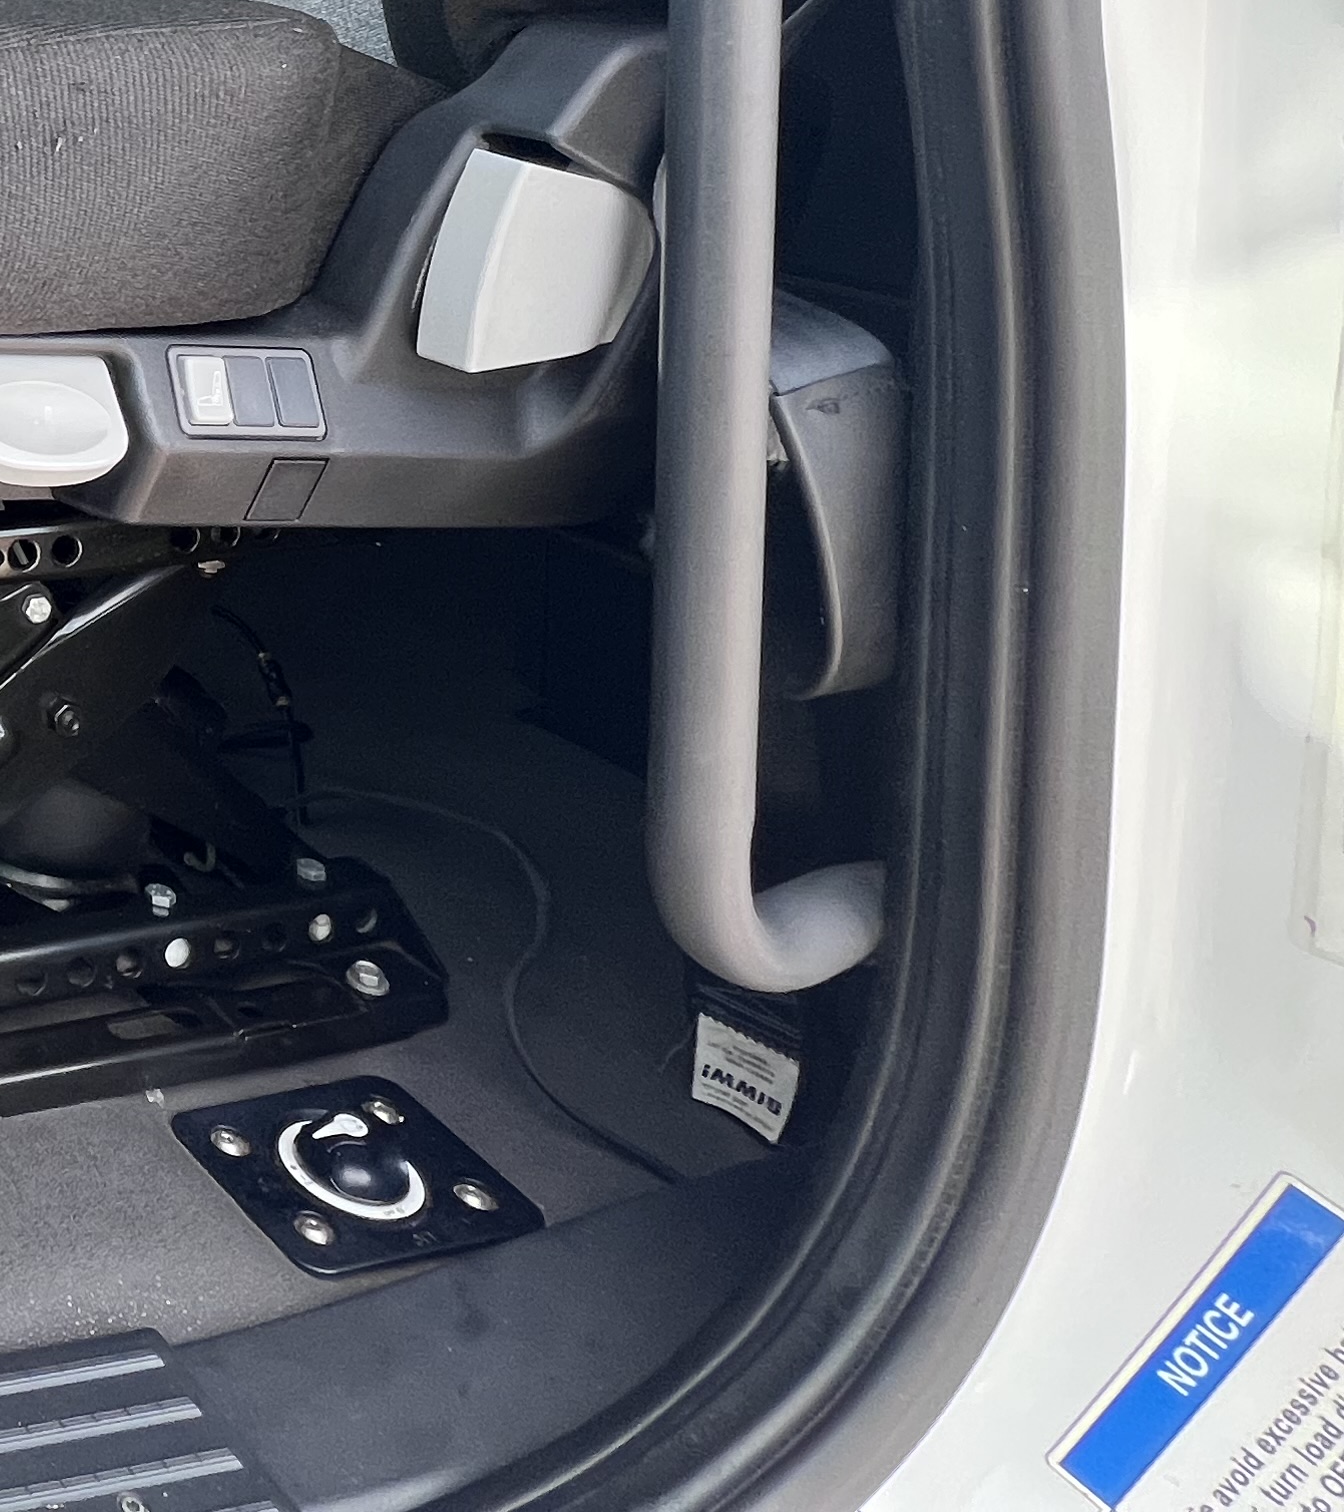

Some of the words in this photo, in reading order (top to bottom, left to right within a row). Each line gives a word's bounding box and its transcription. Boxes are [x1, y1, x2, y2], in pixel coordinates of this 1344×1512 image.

[1157, 1293, 1255, 1397] NOTICE
[1213, 1446, 1265, 1507] avoid
[1256, 1364, 1340, 1455] excessive
[1259, 1462, 1310, 1507] turn
[1292, 1416, 1344, 1467] load
